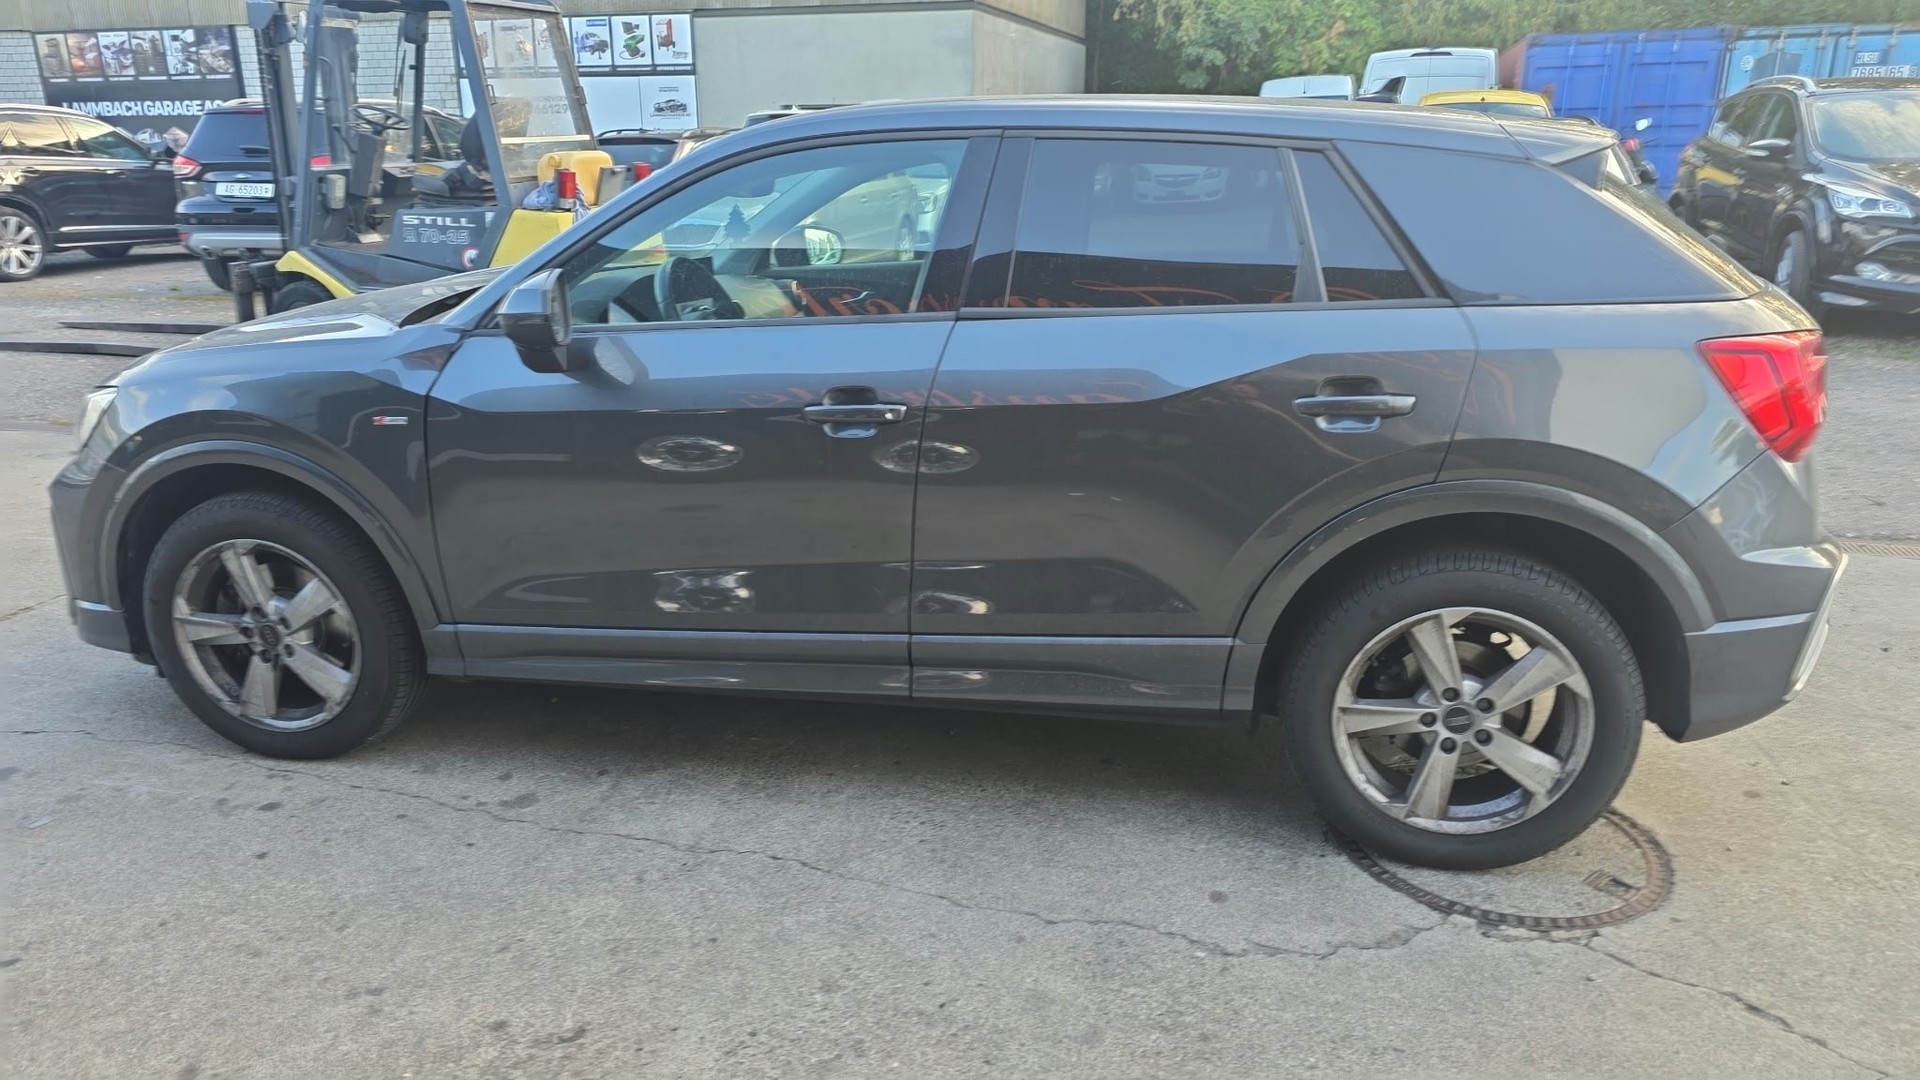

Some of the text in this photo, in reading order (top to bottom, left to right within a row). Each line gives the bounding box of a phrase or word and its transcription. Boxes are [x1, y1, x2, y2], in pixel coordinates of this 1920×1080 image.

[1856, 53, 1879, 63] HLSU
[143, 100, 202, 116] GARAGE
[224, 184, 264, 195] AG 65203
[402, 215, 476, 227] STILL
[418, 227, 470, 245] 70-25
